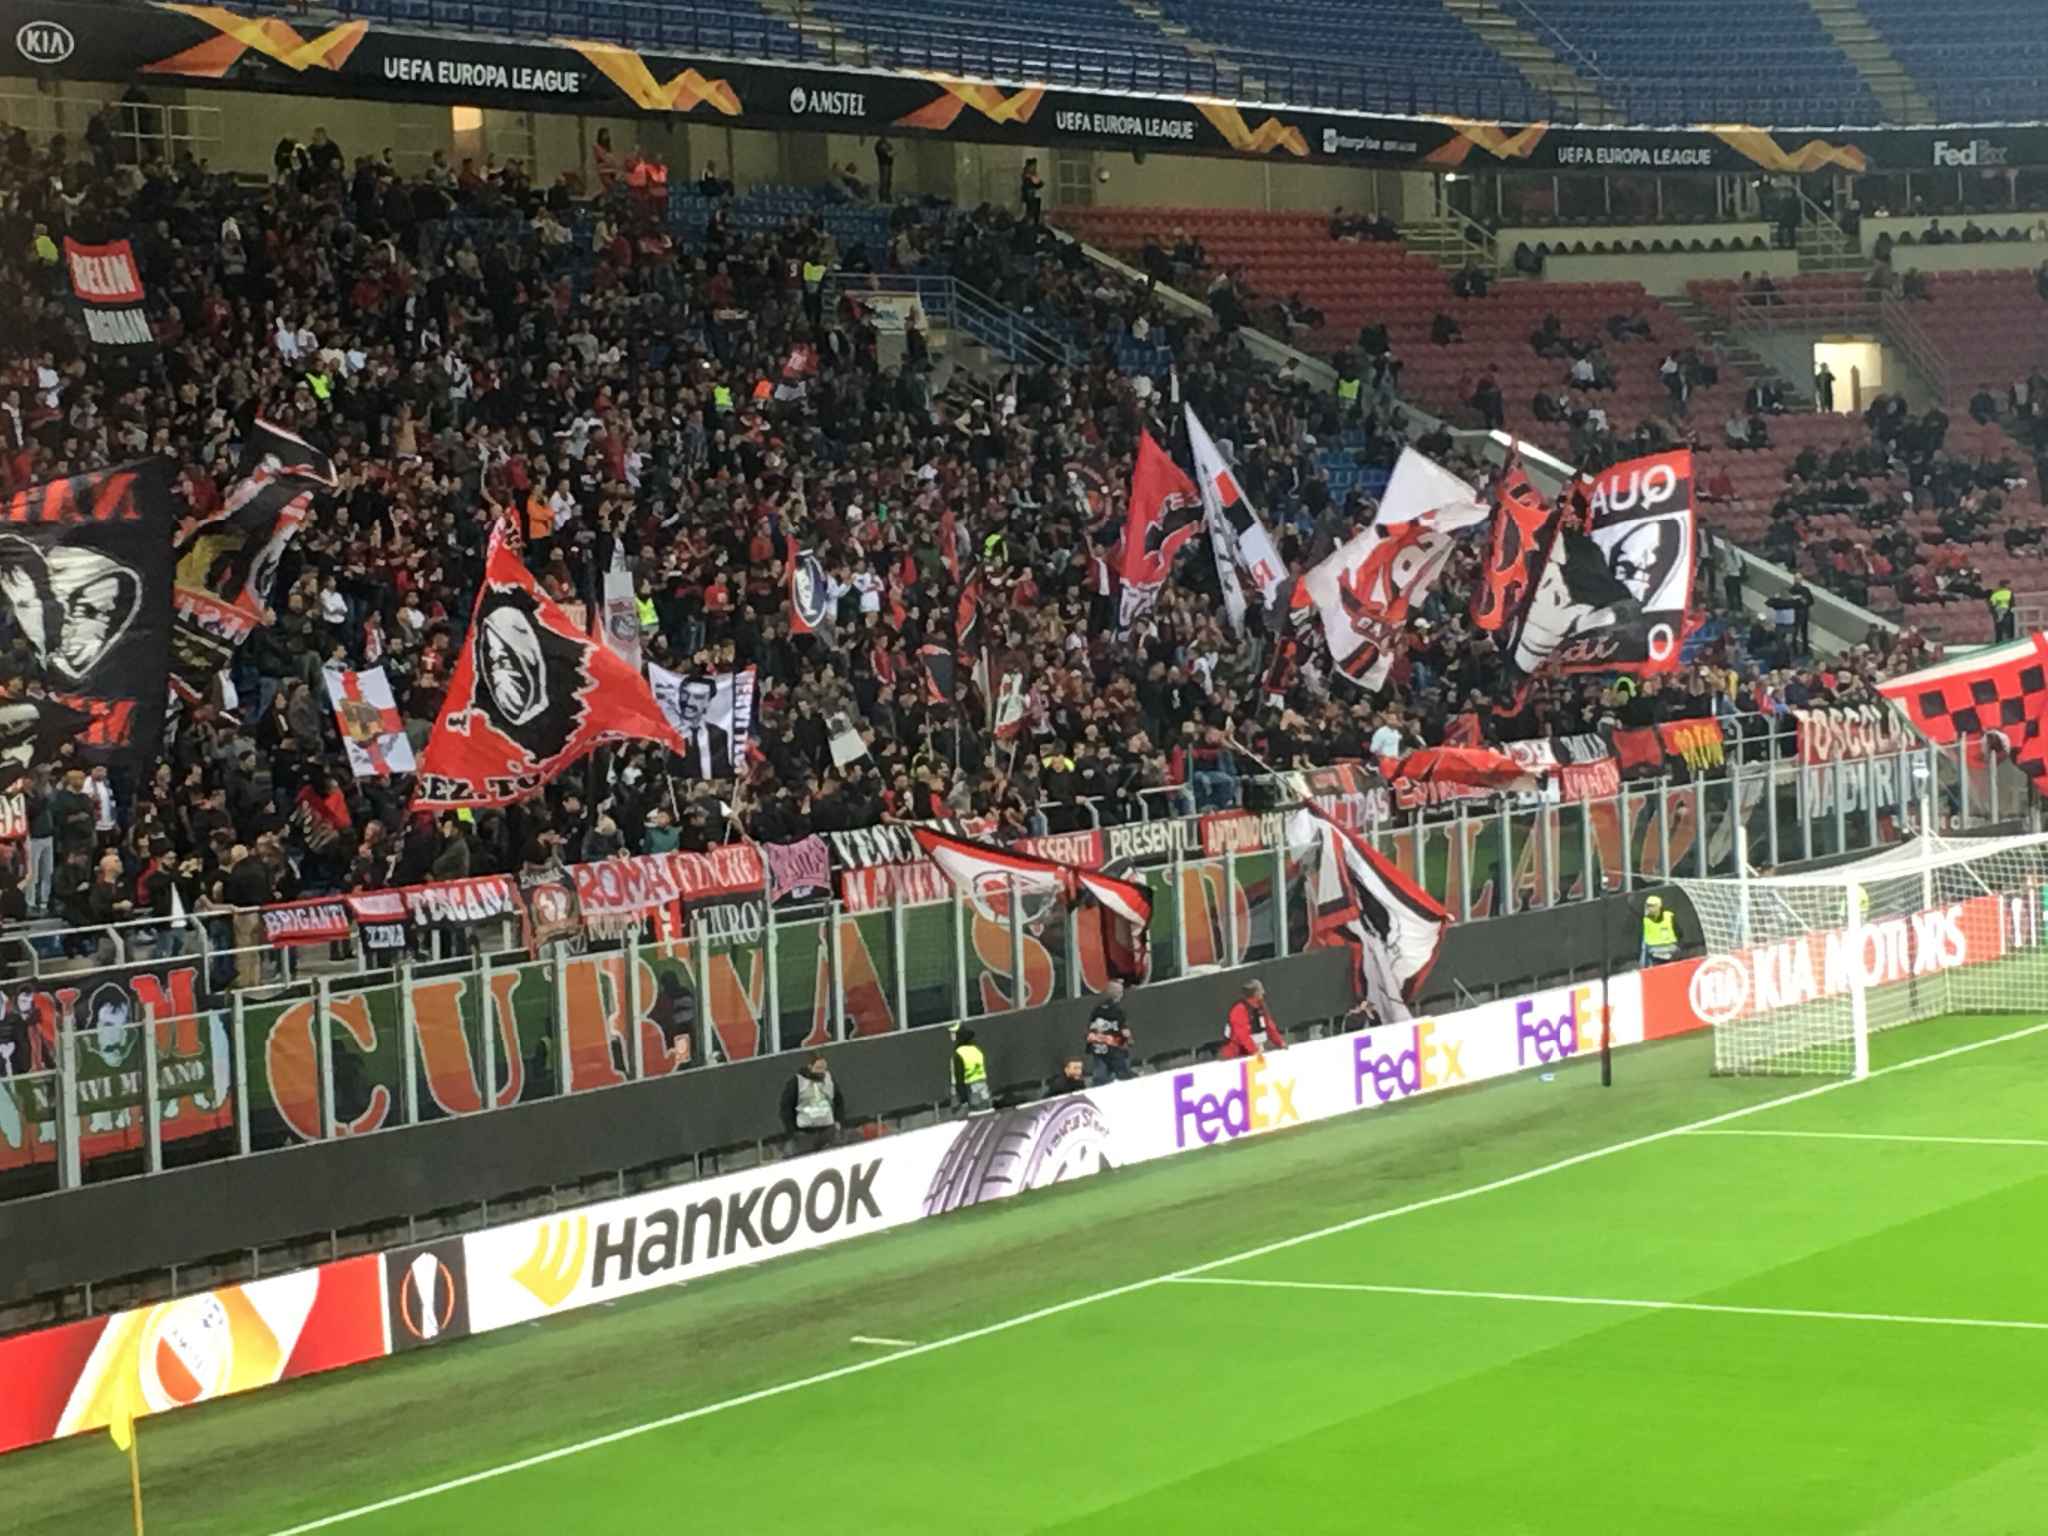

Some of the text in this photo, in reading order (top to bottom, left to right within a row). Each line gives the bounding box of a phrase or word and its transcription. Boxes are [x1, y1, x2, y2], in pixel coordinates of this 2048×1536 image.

[27, 30, 64, 53] KIA
[384, 56, 579, 92] UEFA EUROPA LEAGUE
[808, 90, 866, 116] AMSTEL
[1056, 111, 1194, 139] UEFA EUROPA LEAGUE
[1558, 147, 1711, 165] UEFA EUROPA LEAGUE
[1026, 833, 1094, 866] ASSENTI
[573, 855, 679, 909] ROMA
[1752, 937, 1816, 1012] KIA
[264, 916, 896, 1142] CURVA
[1515, 986, 1617, 1066] FedEx
[1353, 1022, 1466, 1104] FedEx
[1173, 1054, 1300, 1148] FedEx
